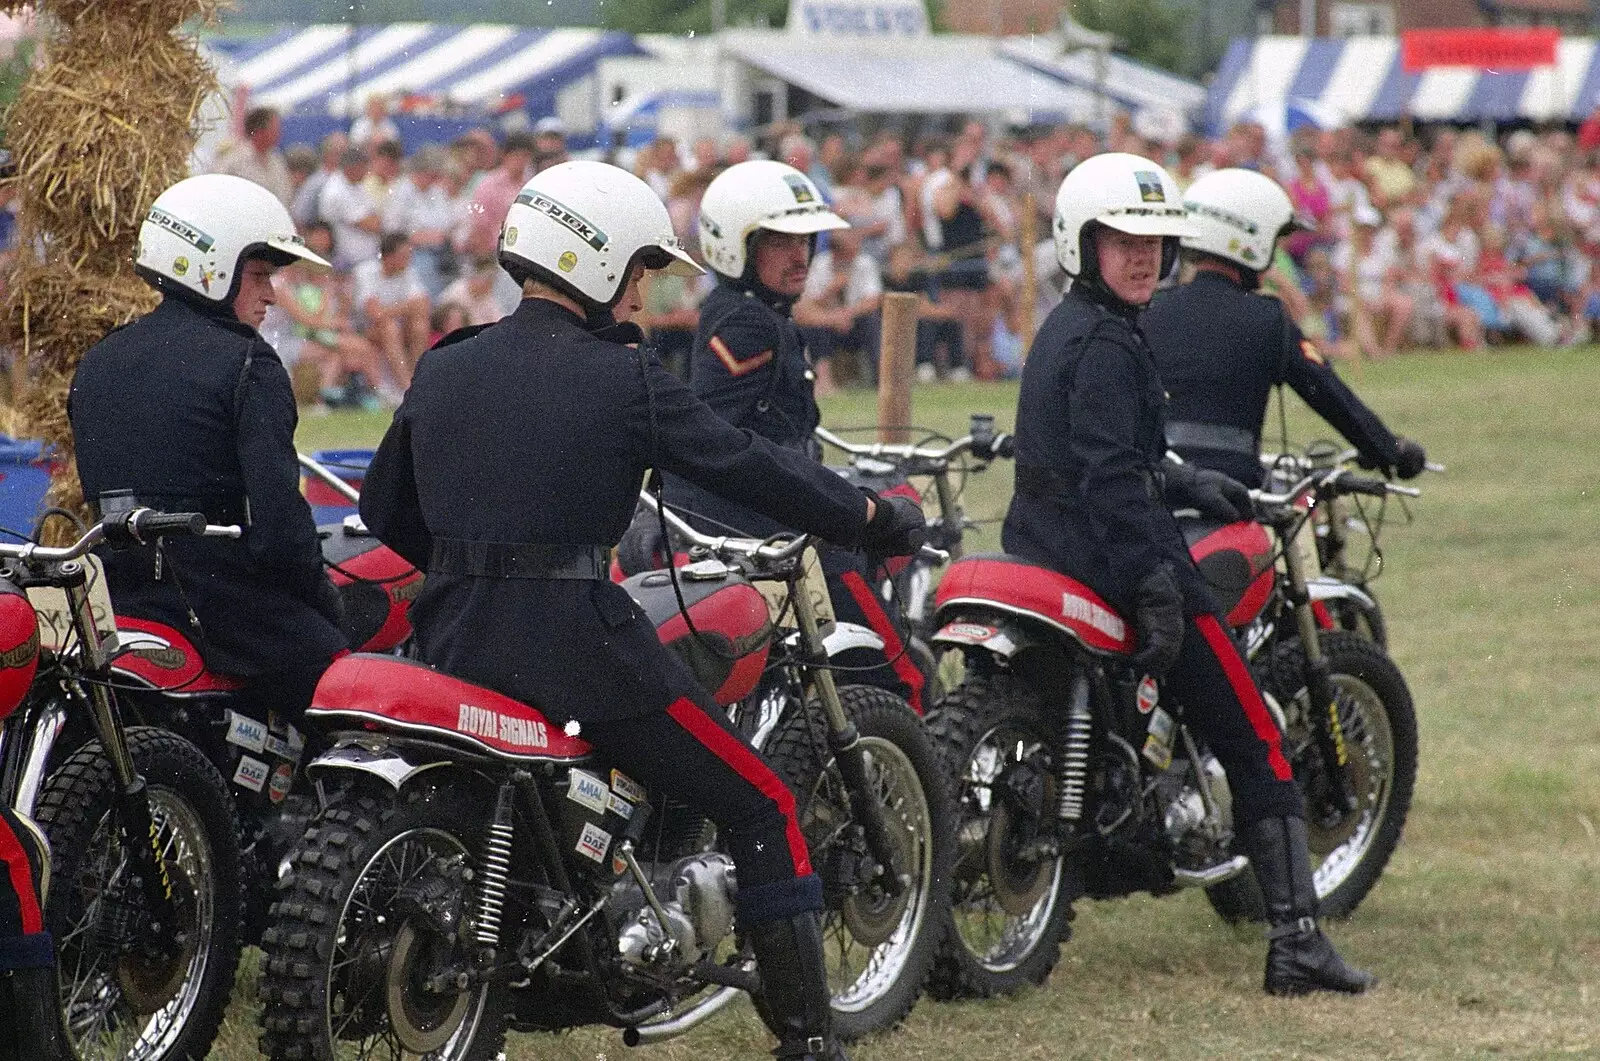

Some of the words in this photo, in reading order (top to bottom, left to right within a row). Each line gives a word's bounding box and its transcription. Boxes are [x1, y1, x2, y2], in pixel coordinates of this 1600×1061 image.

[457, 703, 498, 738] ROYAL
[499, 713, 548, 748] SIGNALS
[241, 766, 264, 779] DAF
[577, 779, 602, 800] AMAL
[583, 834, 605, 850] DAF
